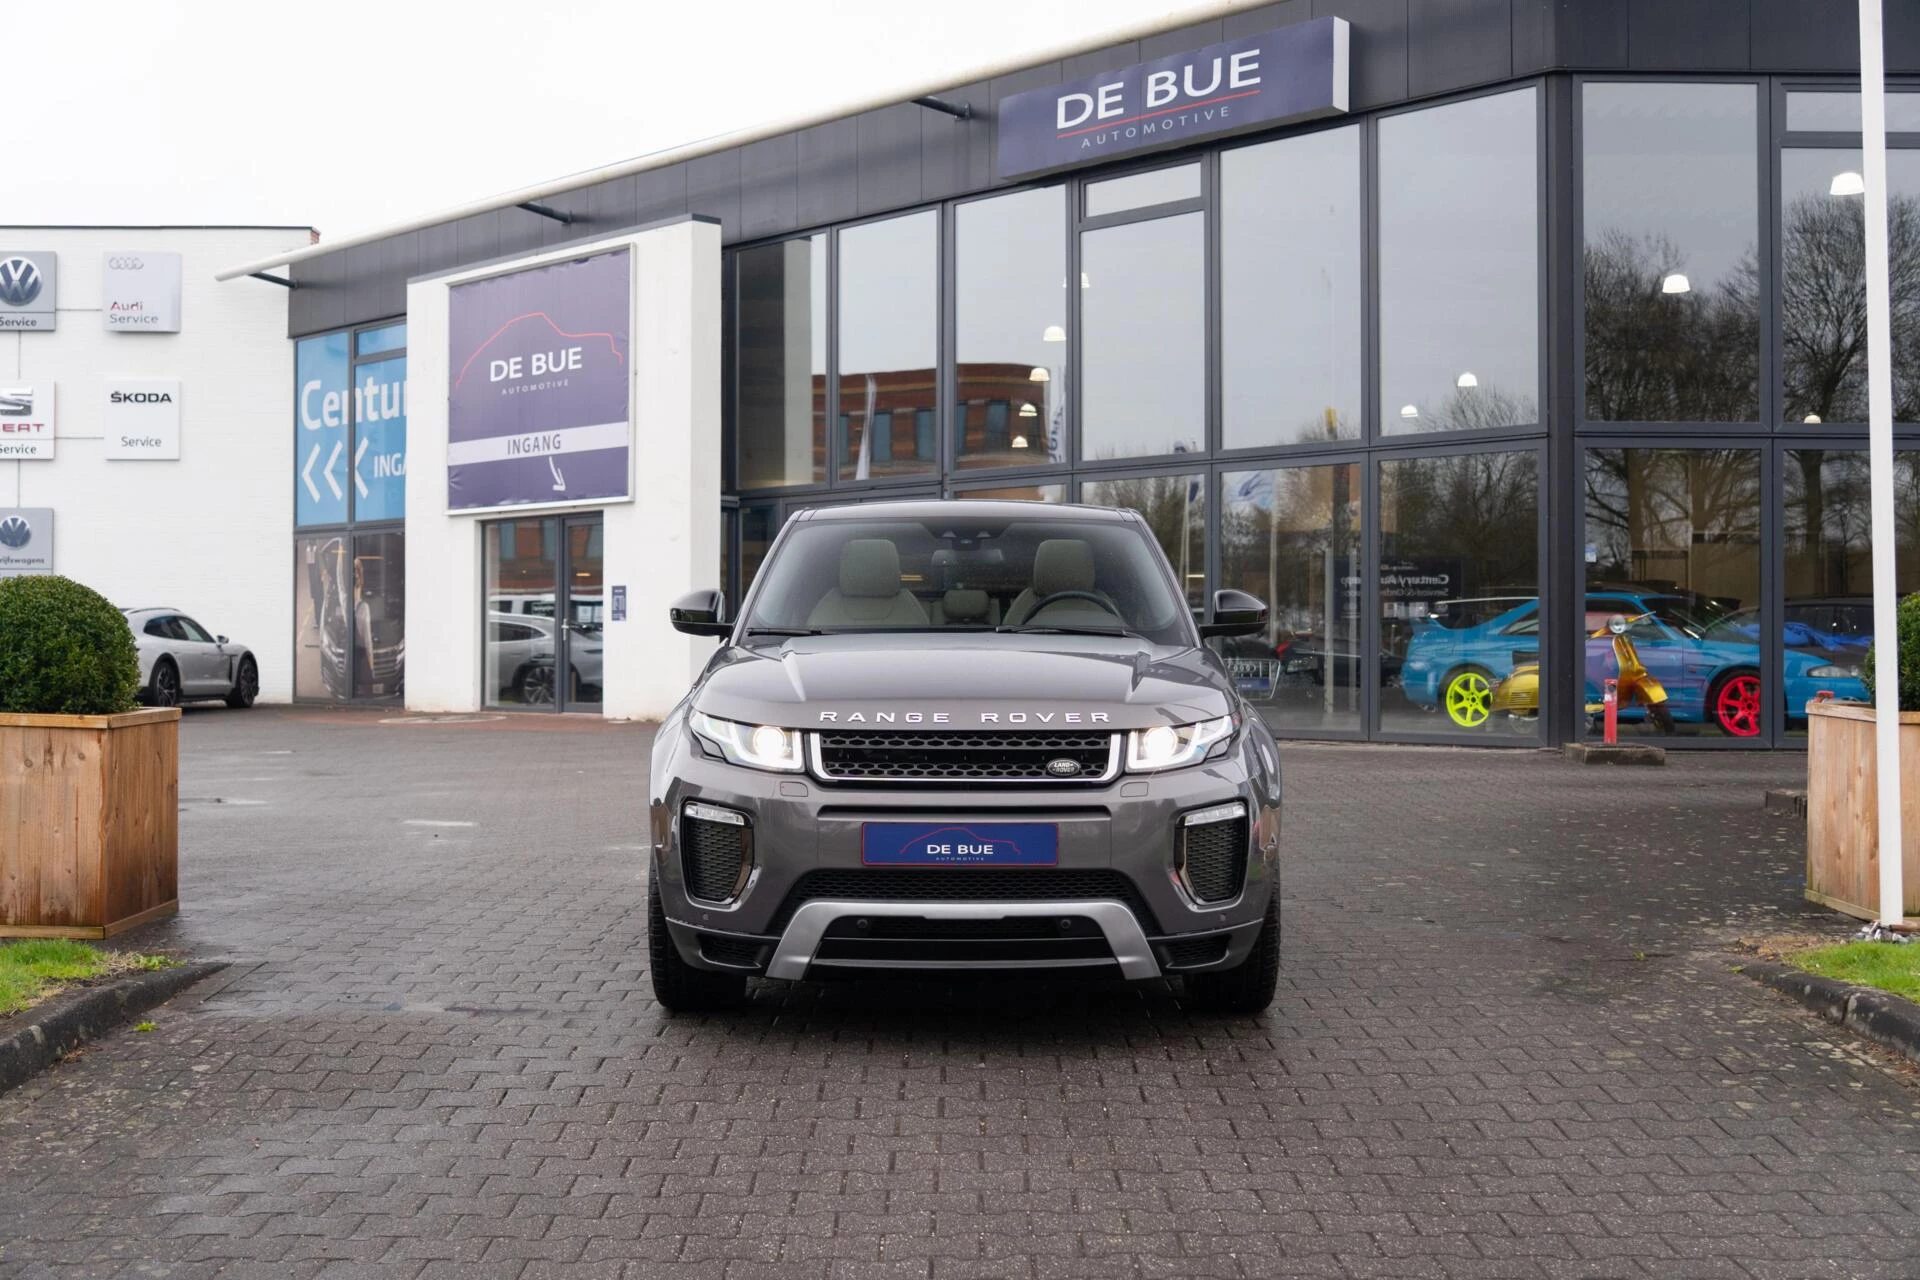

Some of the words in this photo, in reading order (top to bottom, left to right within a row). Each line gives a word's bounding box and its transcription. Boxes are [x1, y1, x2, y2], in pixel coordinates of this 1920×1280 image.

[1056, 81, 1125, 130] DE
[1146, 48, 1261, 109] BUE
[1080, 105, 1231, 150] AUTOMOTIVE
[110, 301, 143, 311] Audi
[110, 313, 159, 324] Service
[490, 356, 523, 382] DE
[531, 346, 583, 376] BUE
[501, 379, 569, 395] AUTOMOTIVE
[110, 391, 172, 403] ŠKODA
[0, 423, 45, 433] EAT
[121, 435, 162, 448] Service
[507, 433, 562, 456] INGANG
[819, 711, 950, 723] RANGE
[980, 711, 1110, 723] ROVER
[926, 844, 951, 855] DE
[957, 844, 994, 855] BUE
